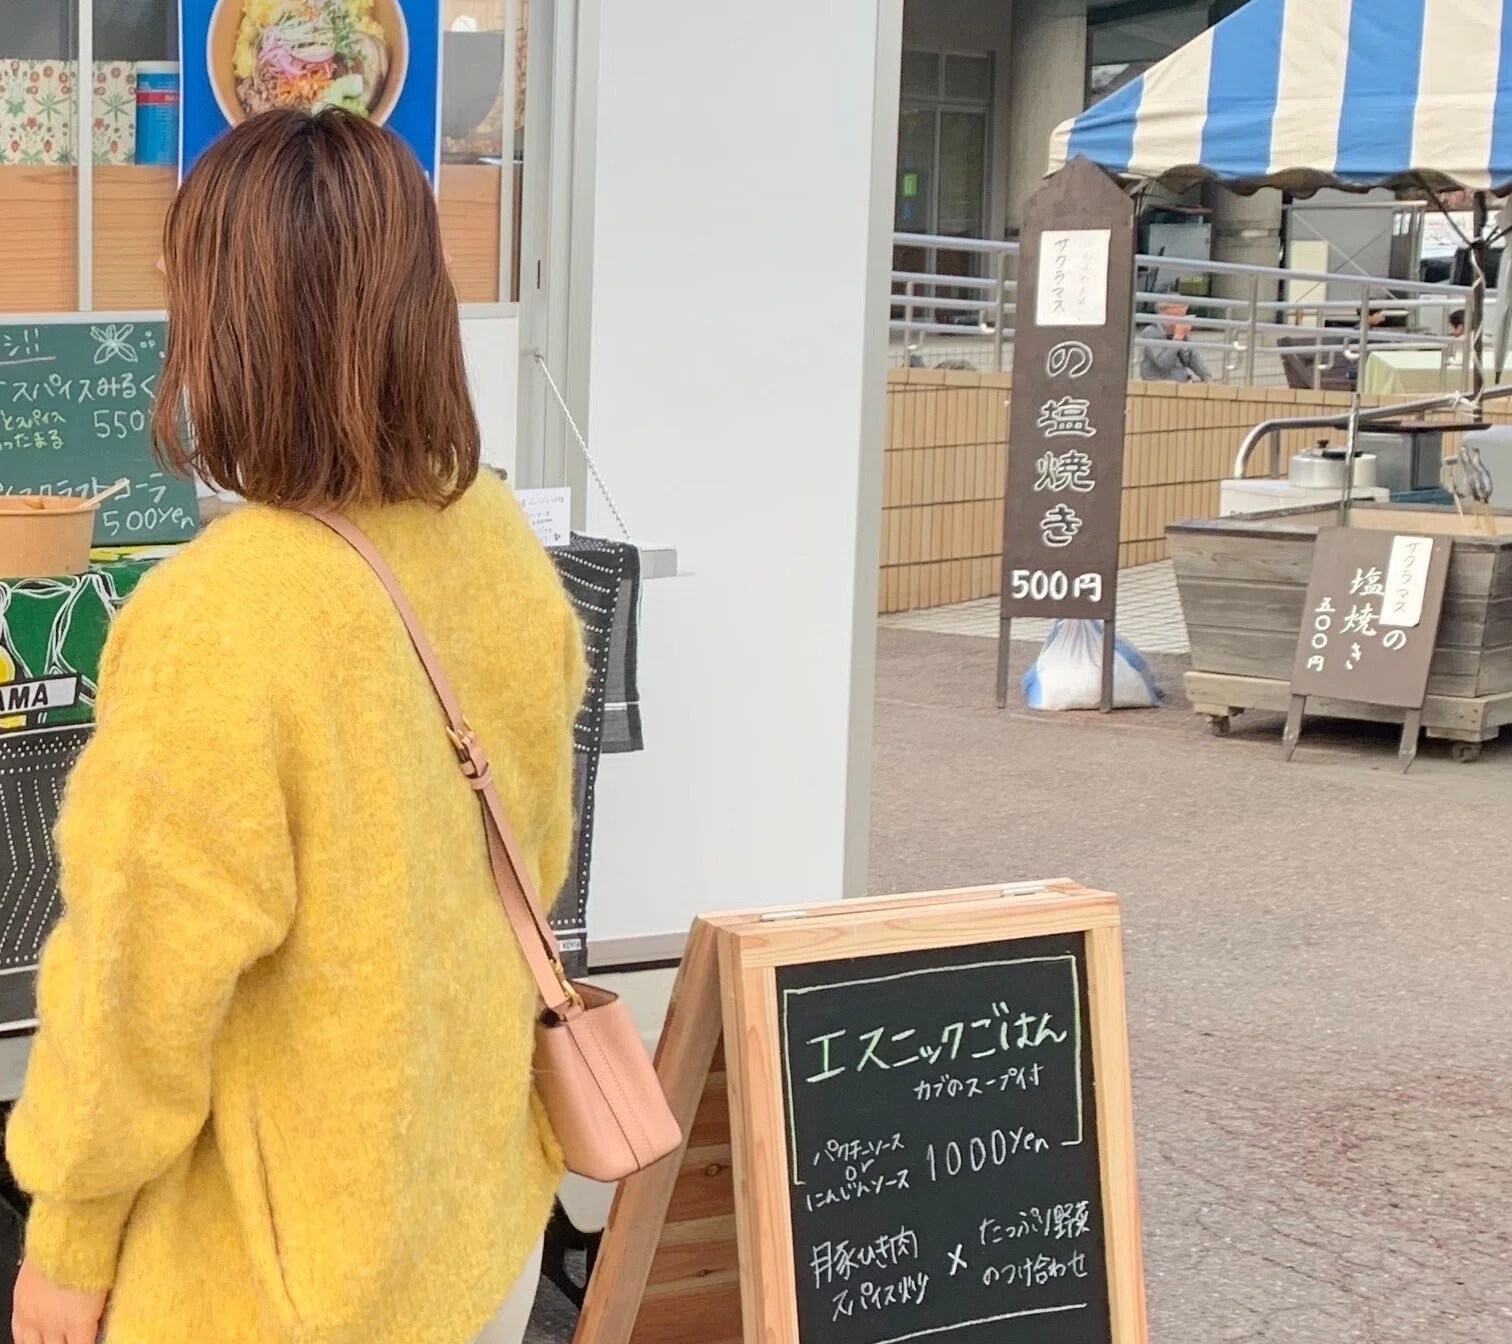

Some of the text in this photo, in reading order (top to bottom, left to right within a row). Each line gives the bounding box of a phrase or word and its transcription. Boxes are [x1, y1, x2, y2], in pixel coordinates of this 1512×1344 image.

[1034, 340, 1096, 547] の塩焼き
[103, 505, 195, 537] 500yen
[1010, 569, 1103, 603] 500円
[1339, 566, 1385, 670] 塩焼き
[805, 1001, 1068, 1083] エスニックごはん
[813, 1132, 905, 1166] パクチーソース
[806, 1168, 910, 1212] にんじんソース
[845, 1158, 875, 1182] or
[979, 1200, 1091, 1246] たっぷり野菜
[982, 1250, 1088, 1287] のつけ合わせ
